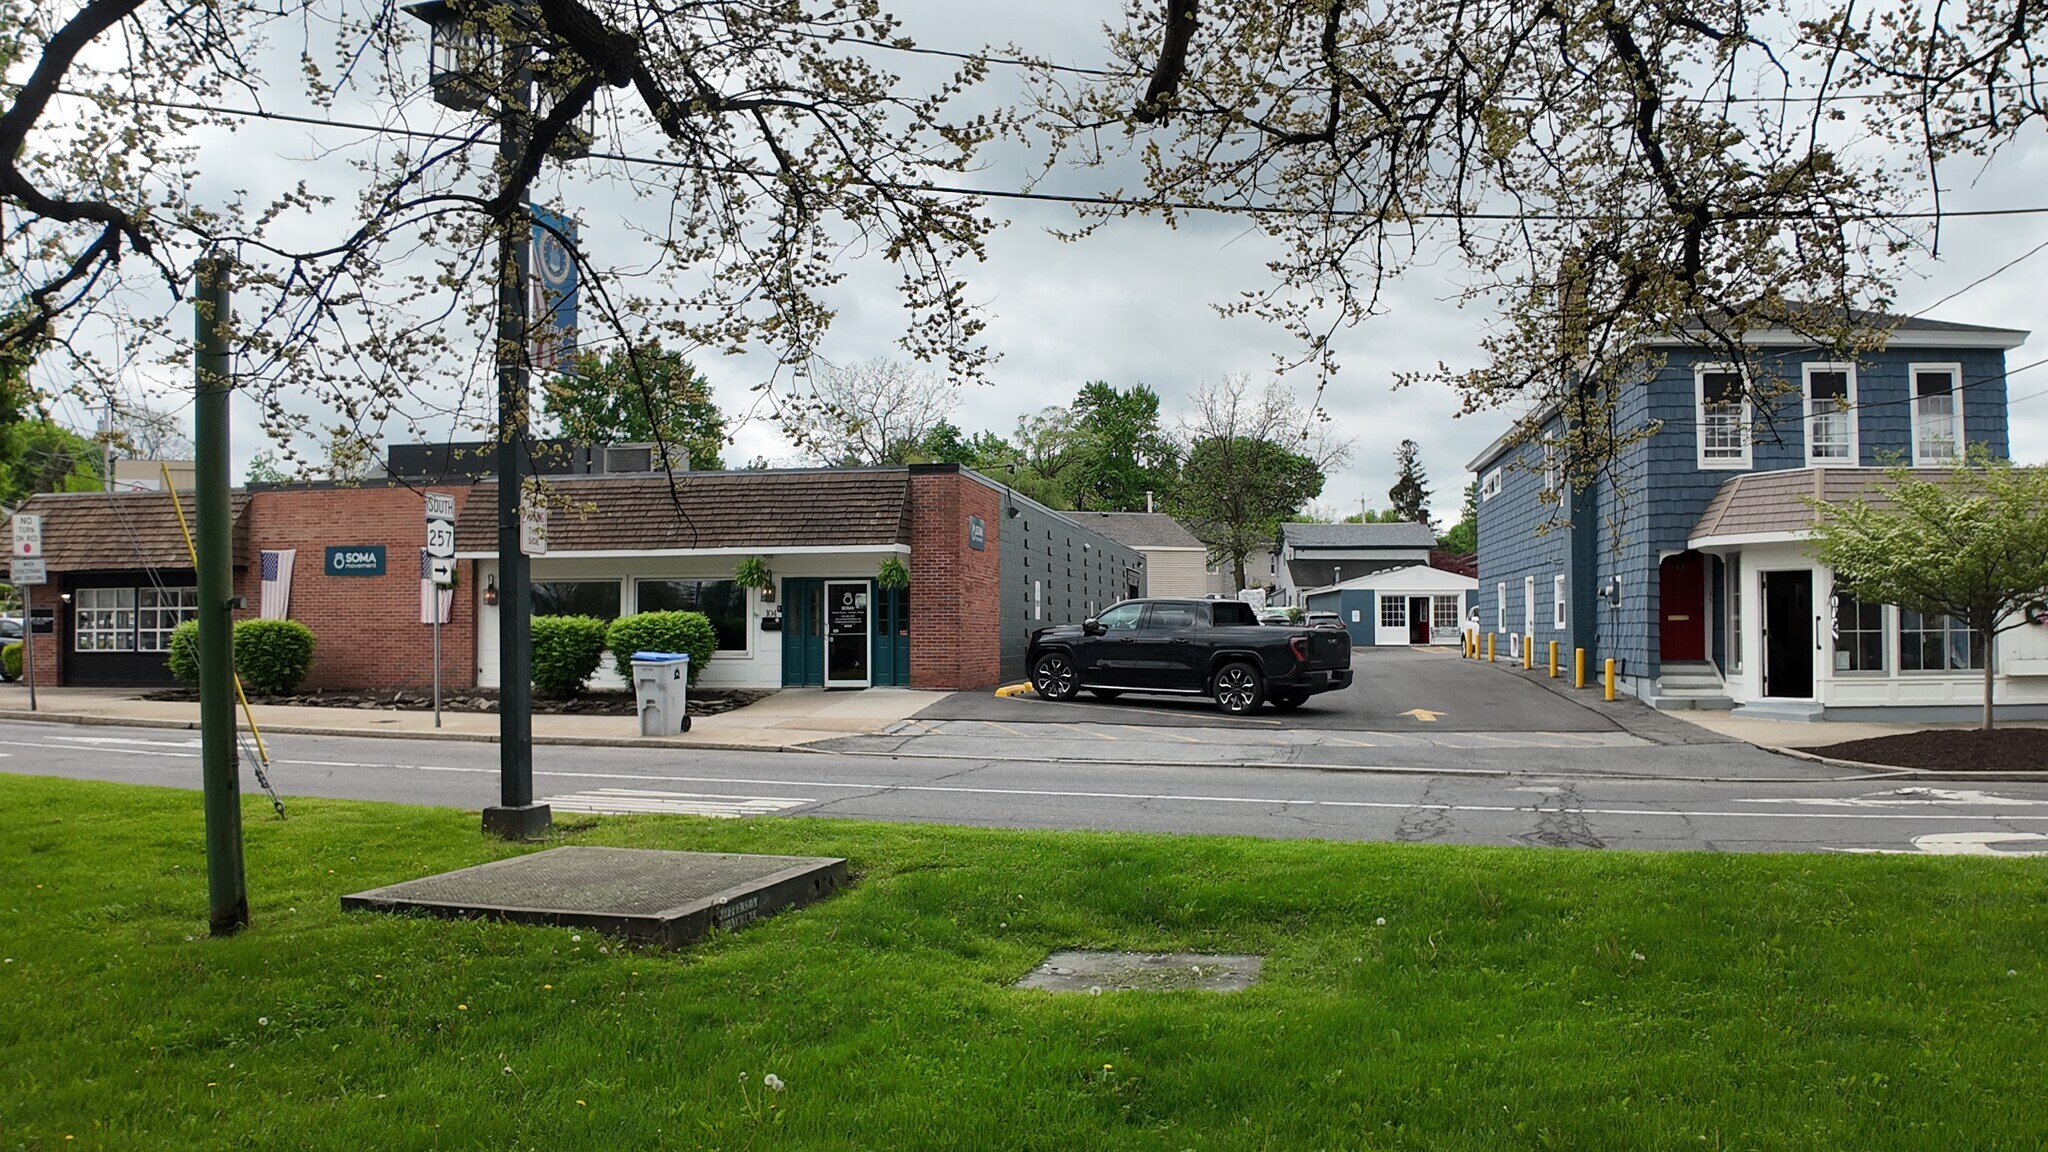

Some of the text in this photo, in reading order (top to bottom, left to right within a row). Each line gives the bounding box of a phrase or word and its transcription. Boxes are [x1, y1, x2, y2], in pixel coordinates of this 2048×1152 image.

[428, 498, 453, 514] SOUTH
[20, 517, 32, 525] NO
[429, 529, 452, 547] 257
[345, 552, 377, 563] SOMA
